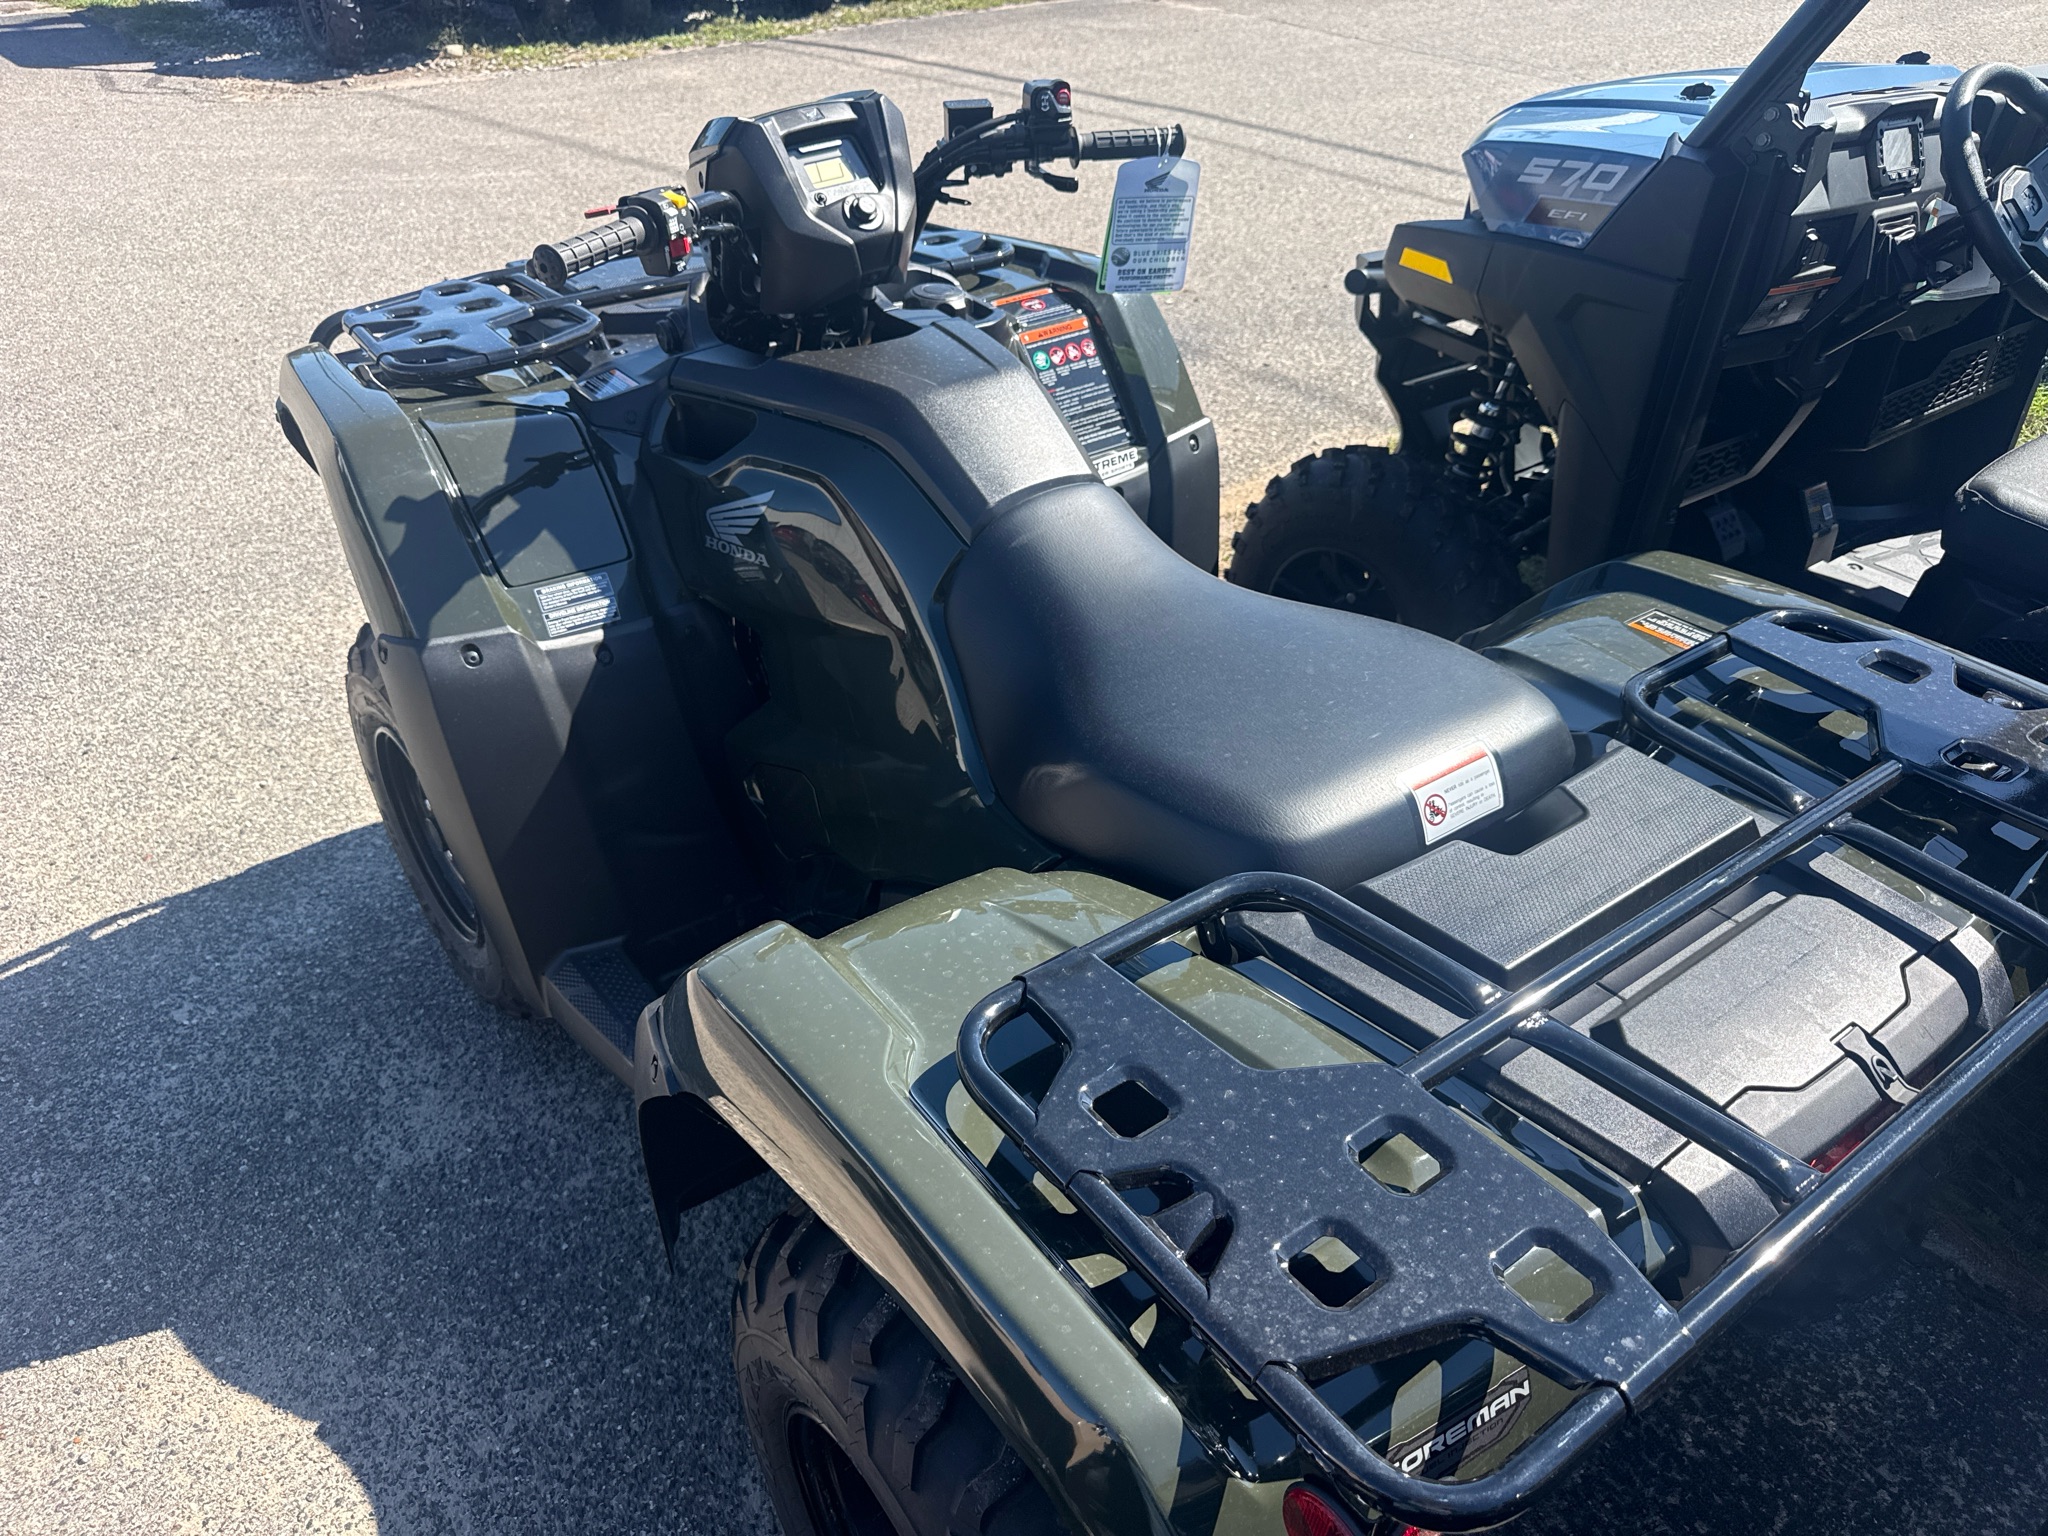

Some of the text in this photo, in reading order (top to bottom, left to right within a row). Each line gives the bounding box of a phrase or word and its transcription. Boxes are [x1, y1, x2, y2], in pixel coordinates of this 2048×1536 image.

[1517, 157, 1629, 191] 570
[1547, 208, 1588, 221] EFI
[1117, 268, 1135, 276] BEST
[1095, 450, 1136, 471] TREME
[705, 535, 770, 568] HONDA
[1444, 784, 1457, 794] NEVER
[1393, 1379, 1530, 1473] OREMAN
